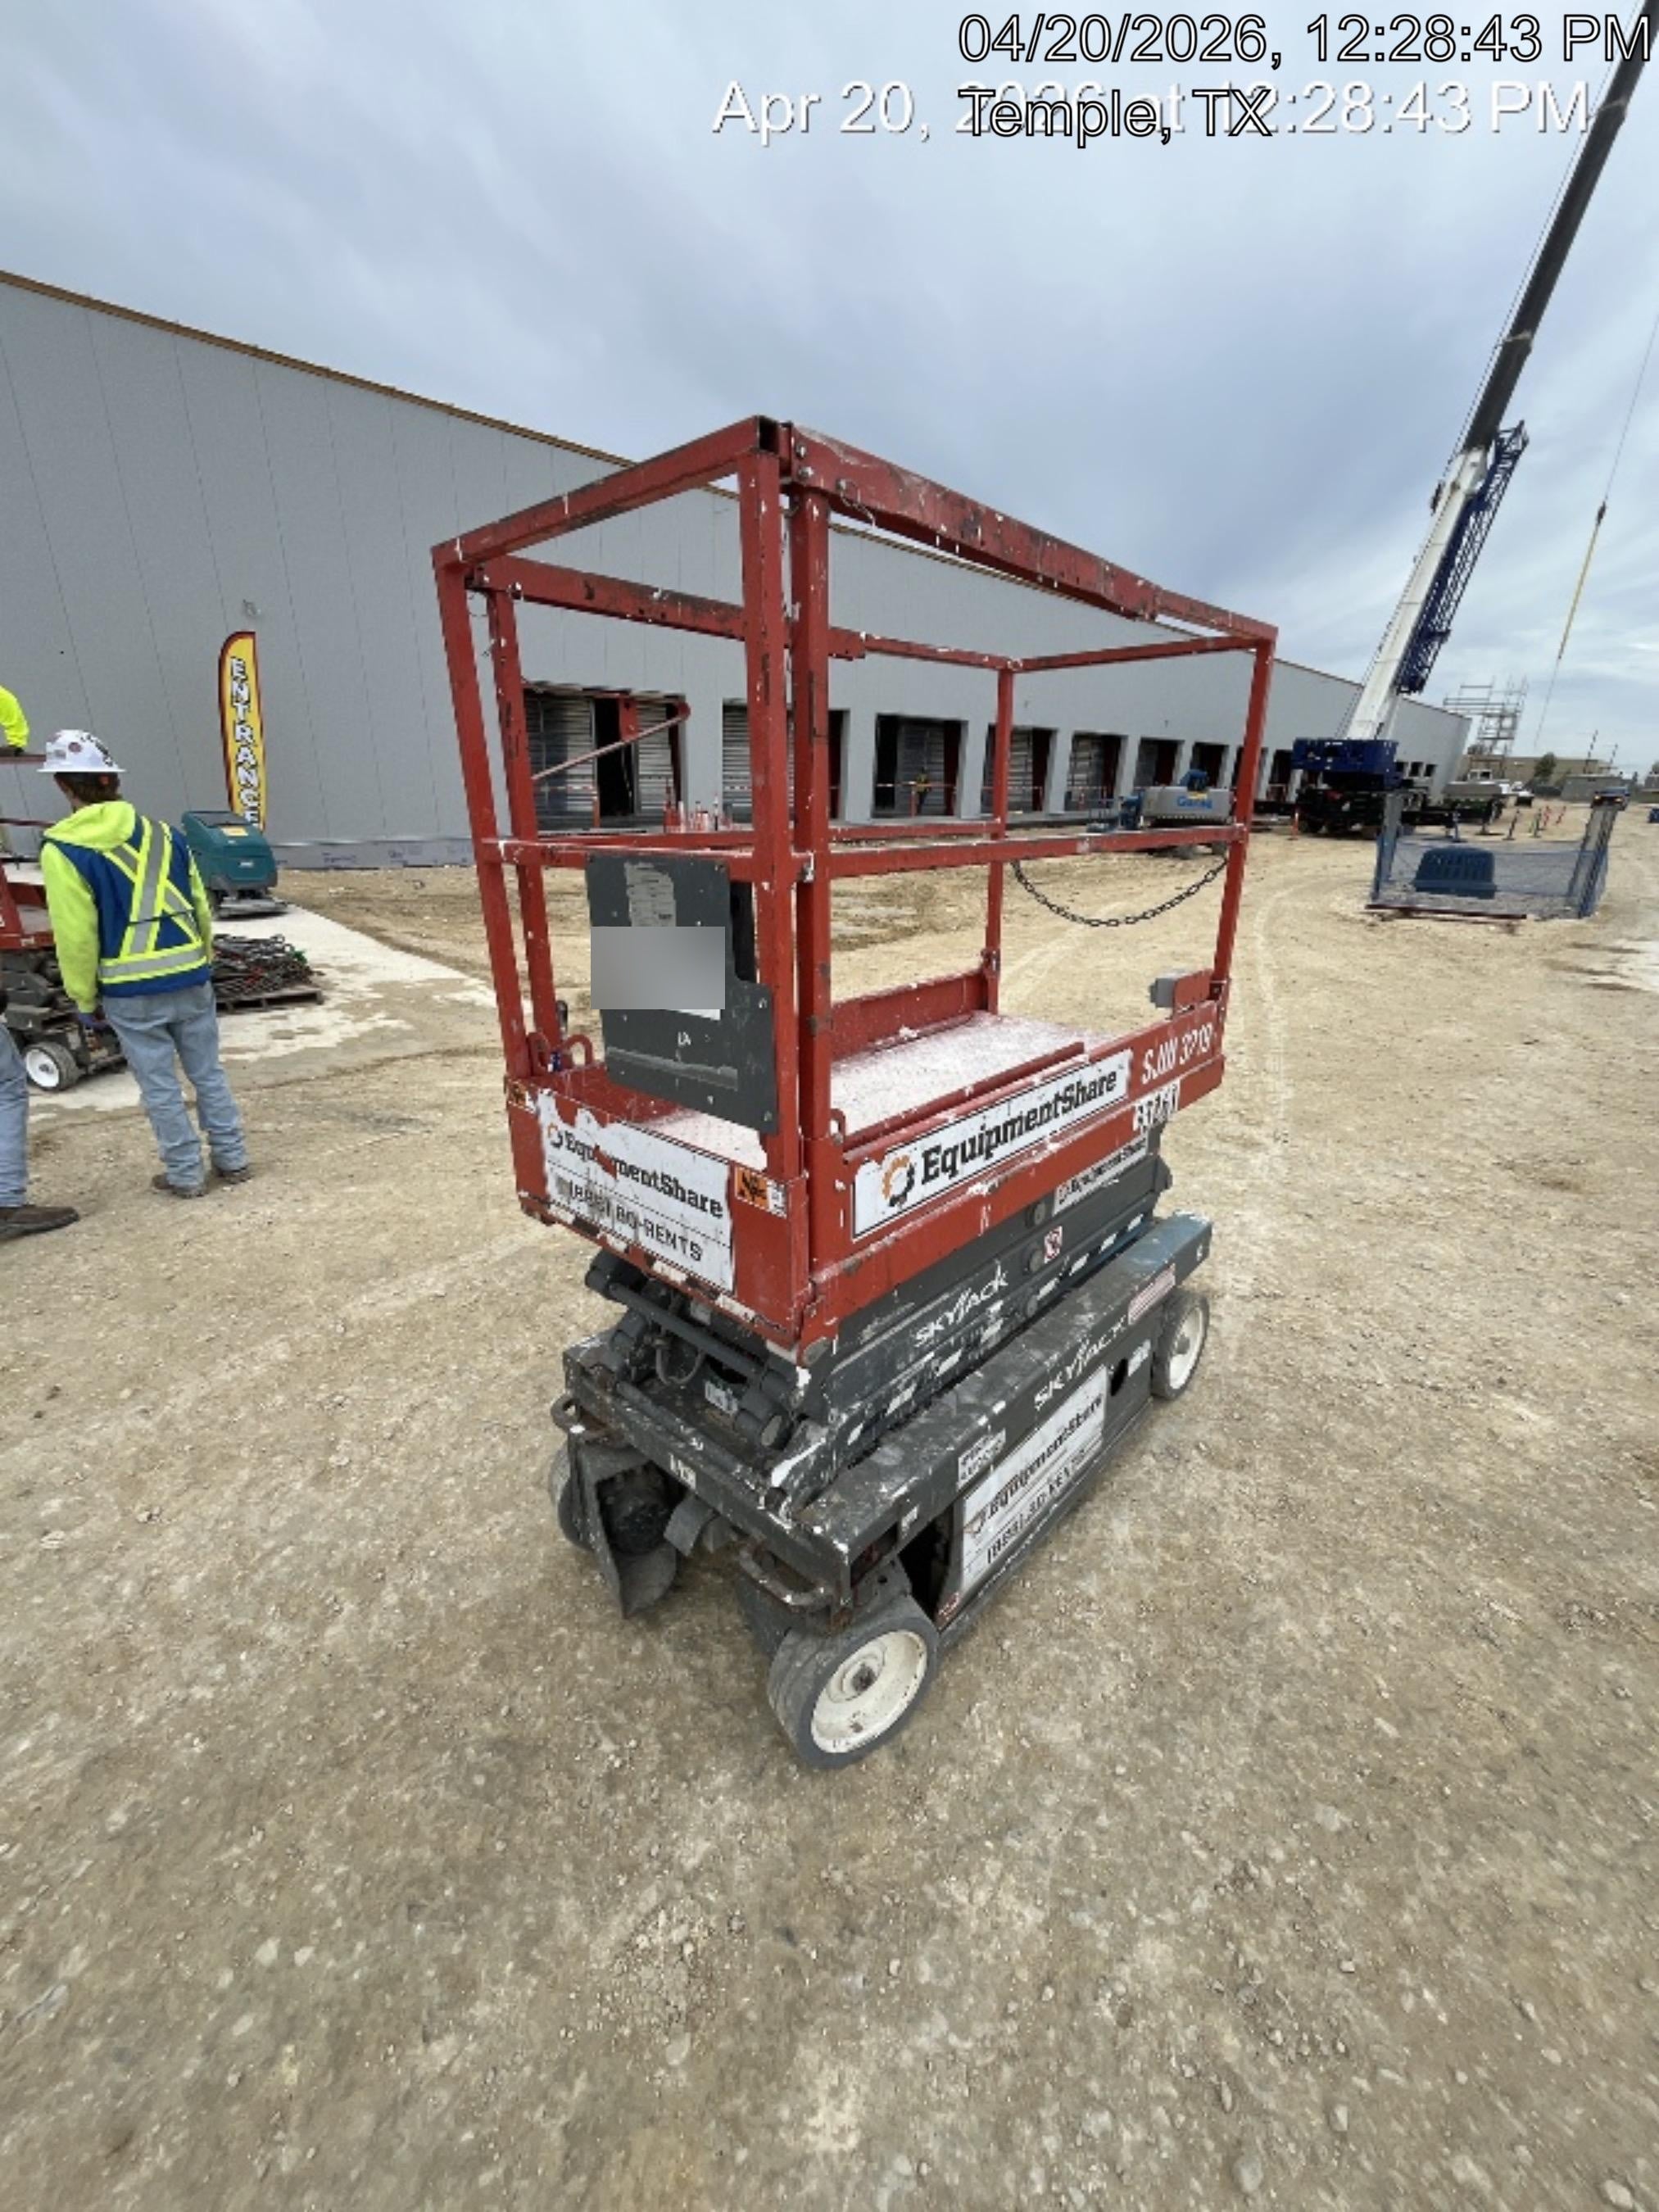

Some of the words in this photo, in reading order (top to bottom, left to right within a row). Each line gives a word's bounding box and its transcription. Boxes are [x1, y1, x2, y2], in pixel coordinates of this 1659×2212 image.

[230, 656, 261, 826] ENTRANCE
[564, 1128, 724, 1219] EqumentShare
[921, 1071, 1117, 1185] EquipmentShare
